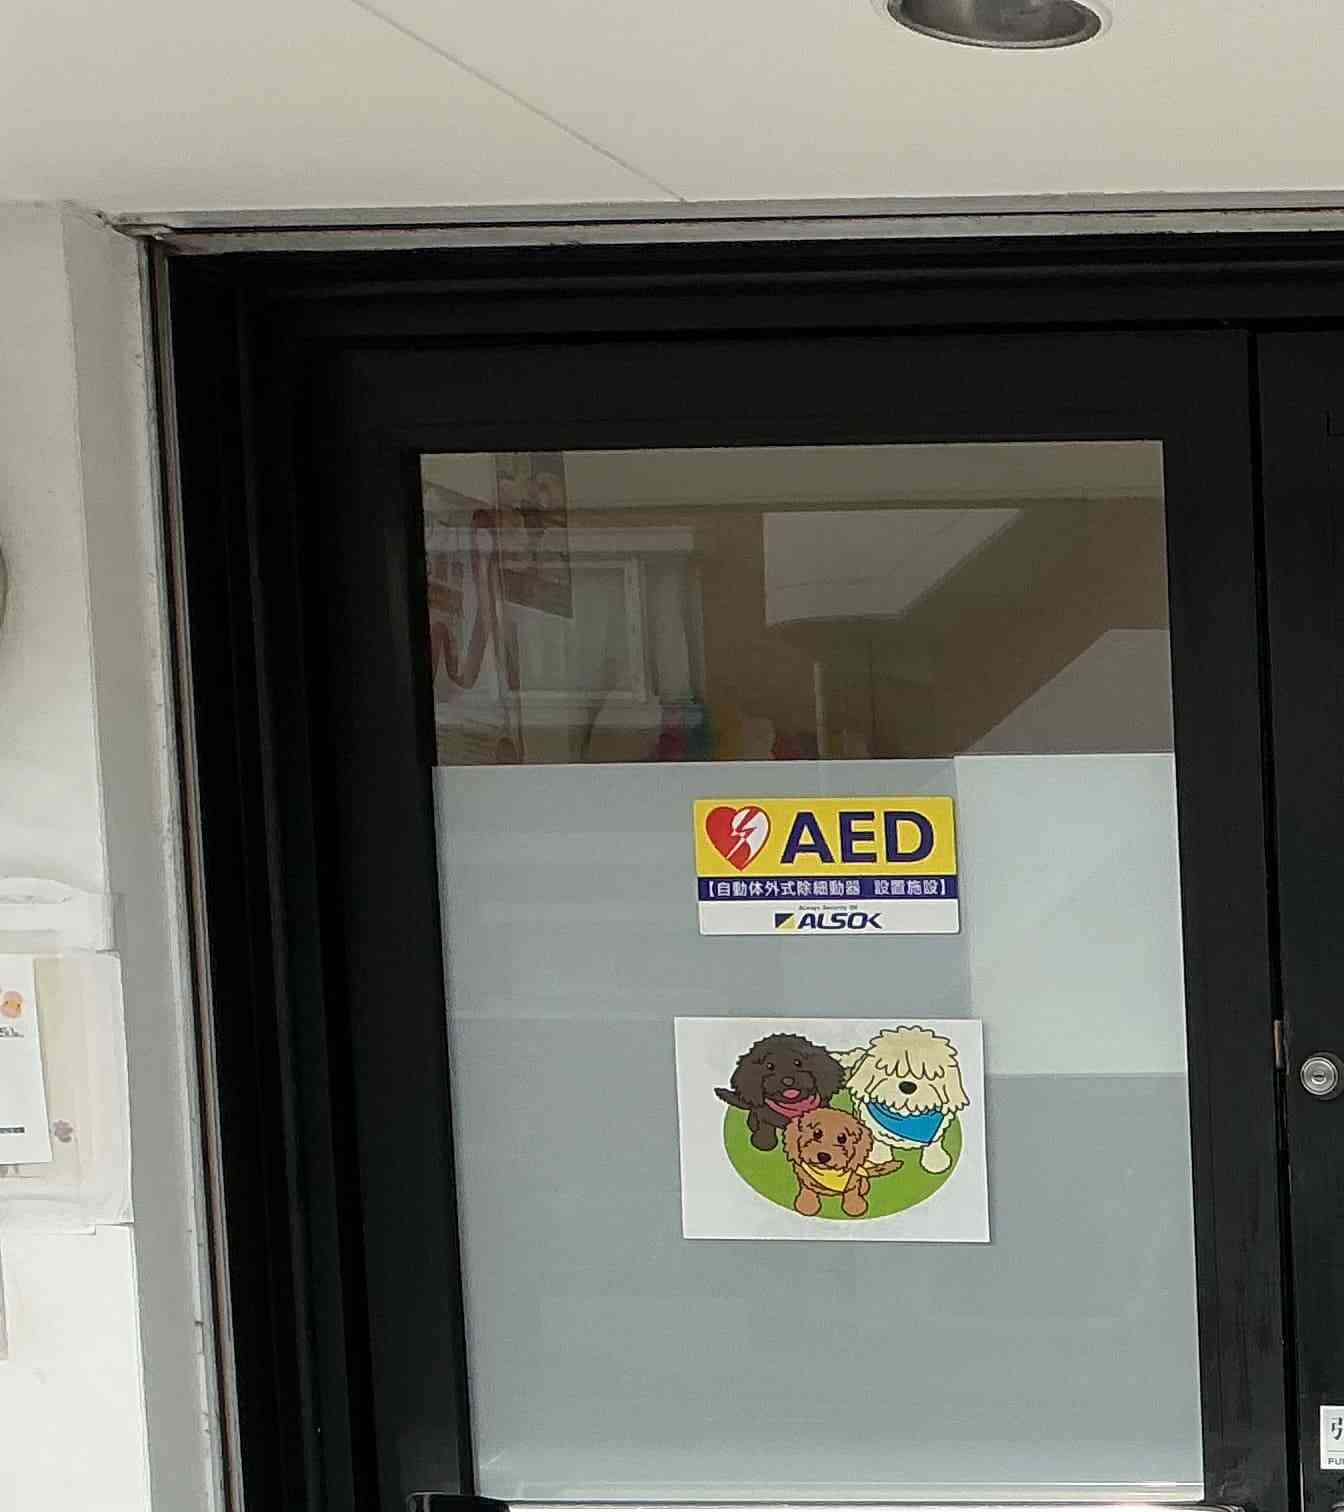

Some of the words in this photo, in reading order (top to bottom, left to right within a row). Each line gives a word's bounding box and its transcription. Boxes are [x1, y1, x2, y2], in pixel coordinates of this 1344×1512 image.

[779, 810, 935, 864] AED
[706, 879, 861, 899] 【自動体外式除細動器
[873, 878, 947, 897] 設置施設】
[797, 912, 883, 930] ALSOK
